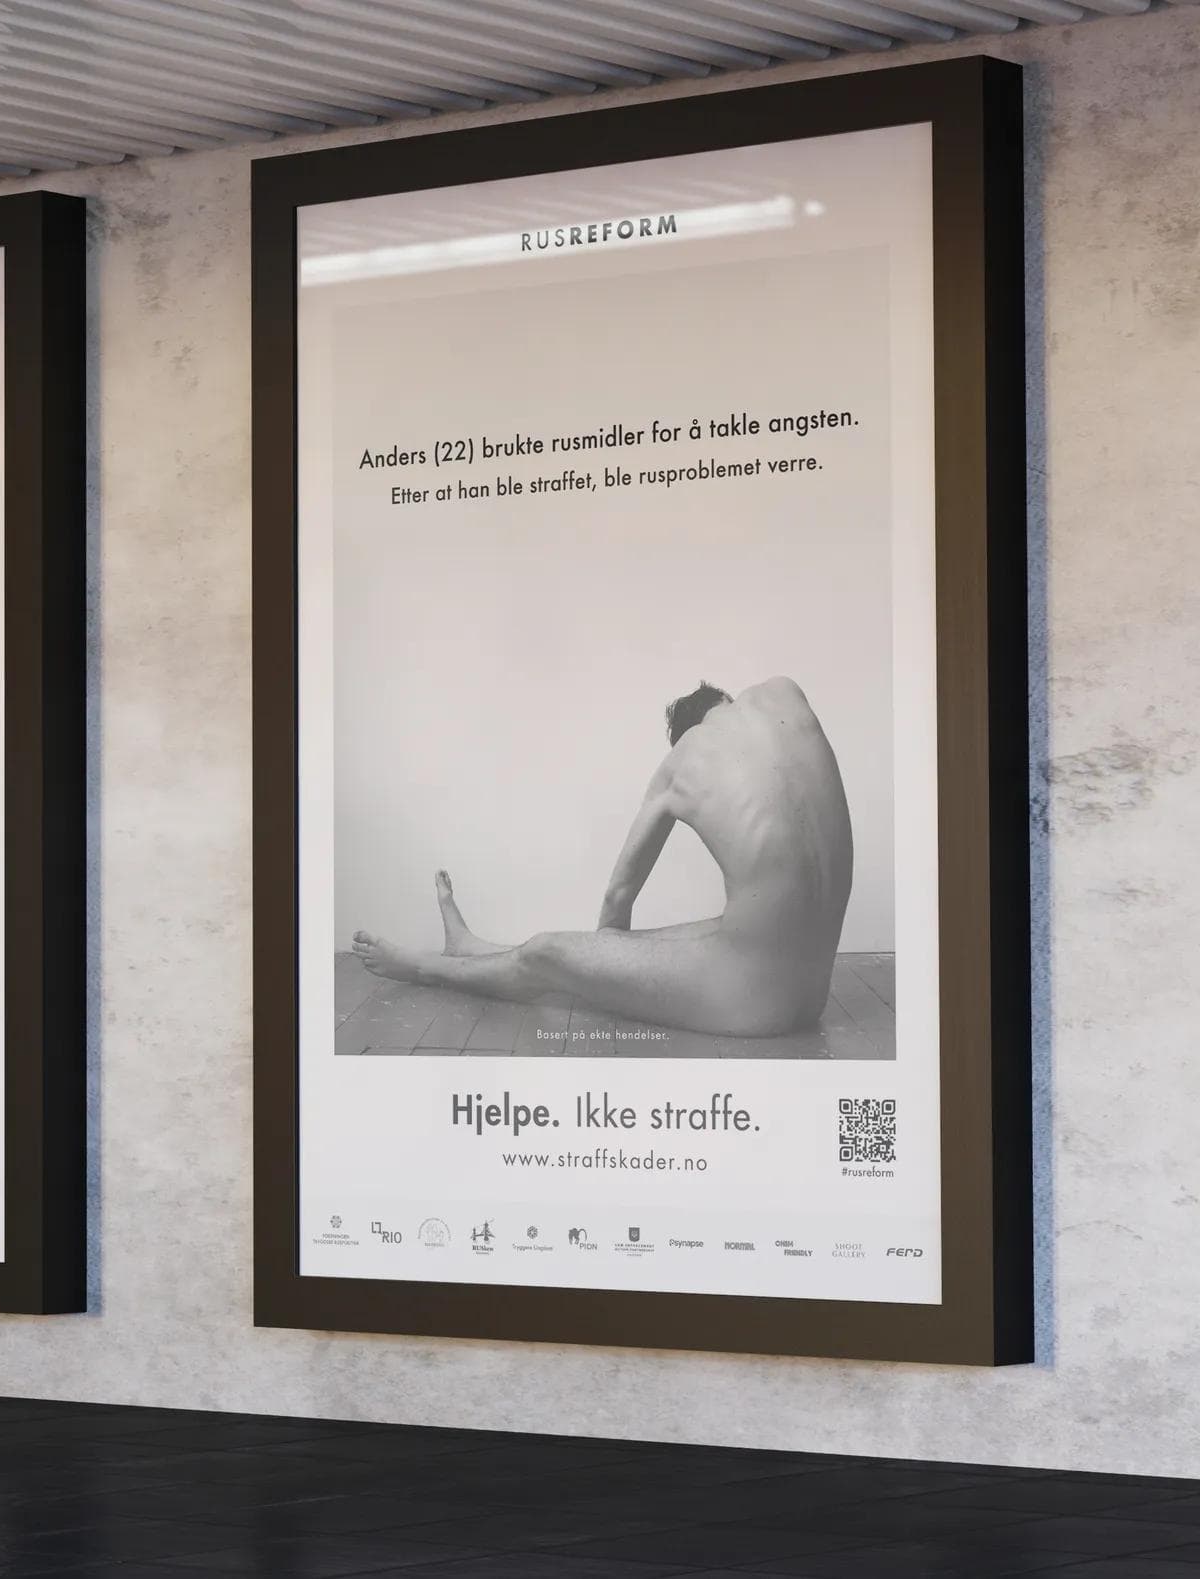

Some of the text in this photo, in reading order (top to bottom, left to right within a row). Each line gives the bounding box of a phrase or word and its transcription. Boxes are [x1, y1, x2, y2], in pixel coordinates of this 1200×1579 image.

[521, 214, 677, 252] RUSREFORM
[359, 409, 859, 470] Anders (22) brukte rusmidler for å takle angsten.
[391, 457, 824, 505] Etter at han ble straffet, ble rusproblemet verre.
[535, 1027, 670, 1044] Basert på ekte hendelser.
[452, 1091, 760, 1137] Hjelpe. Ikke straffe.
[502, 1147, 708, 1171] www.straffskader.no
[840, 1166, 896, 1179] #rusreform
[382, 1230, 403, 1244] RIO
[668, 1238, 704, 1249] Psynapse
